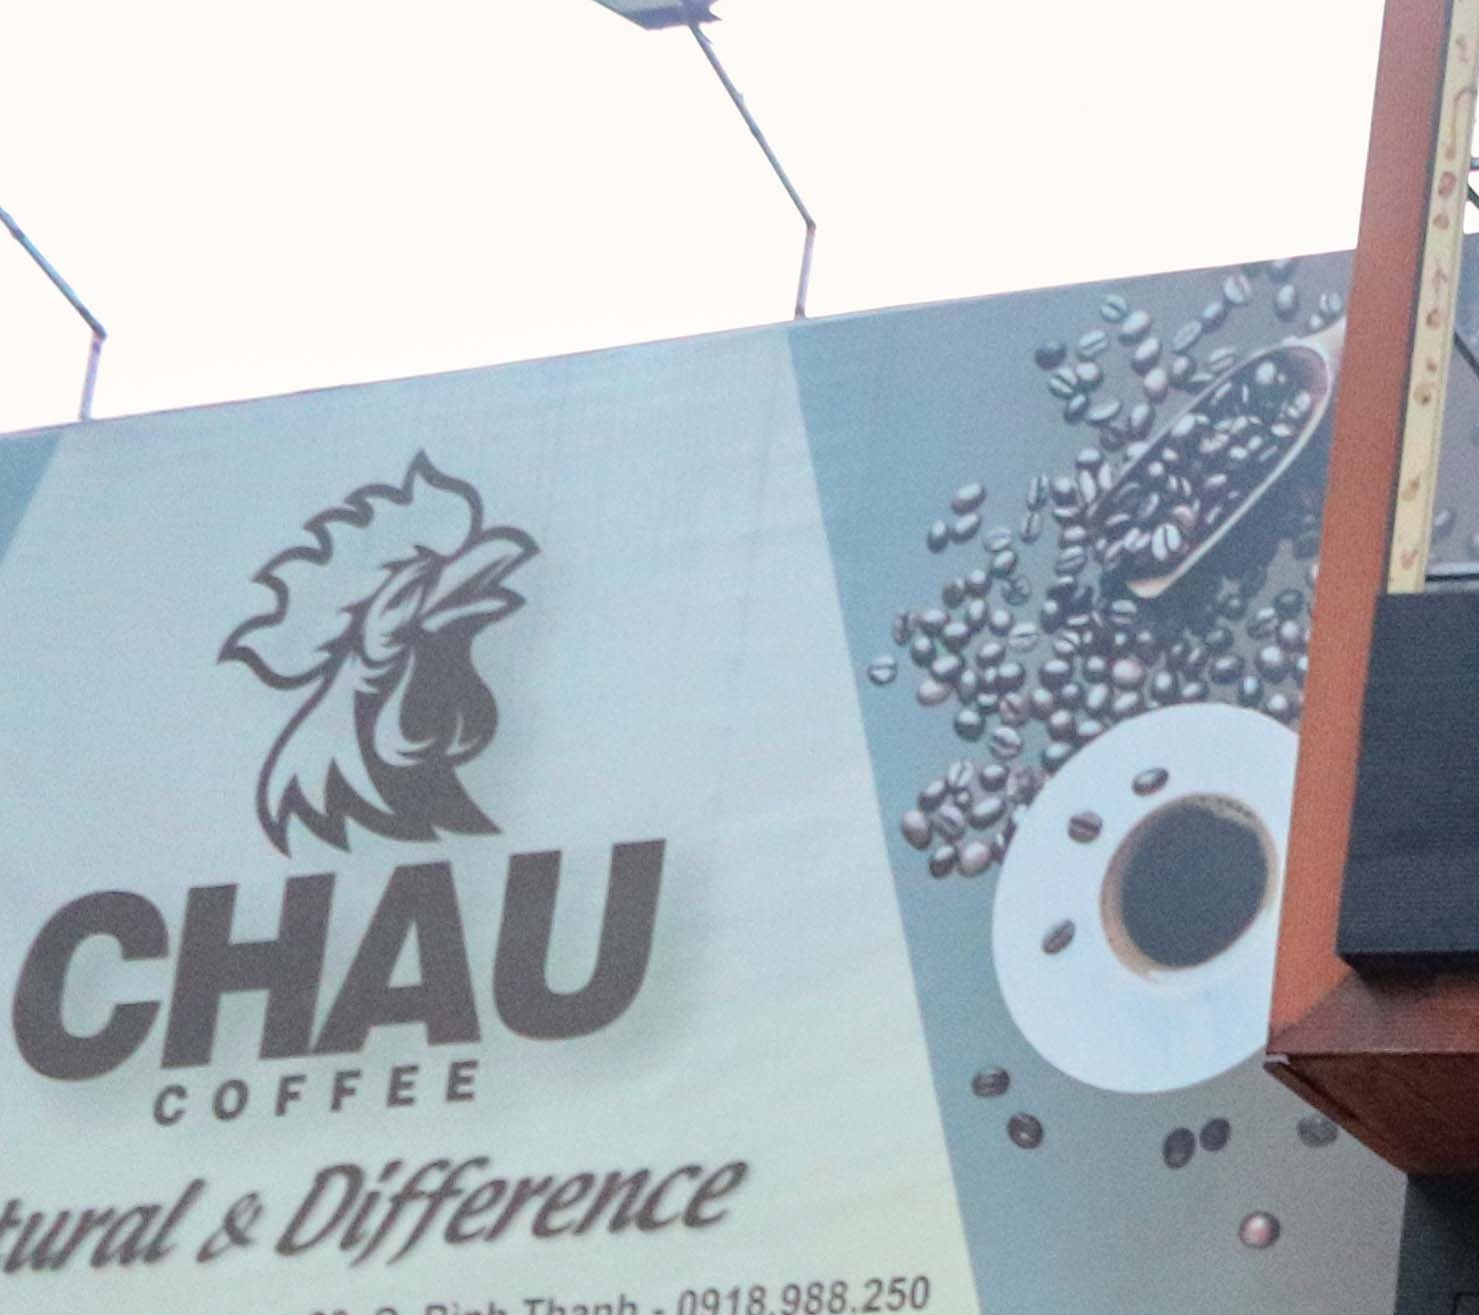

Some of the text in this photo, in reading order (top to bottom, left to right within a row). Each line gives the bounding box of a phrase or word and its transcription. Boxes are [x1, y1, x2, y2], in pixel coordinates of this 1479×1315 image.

[12, 838, 666, 1082] CHAU
[152, 1060, 479, 1126] COFFEE
[196, 1190, 263, 1263] &
[275, 1156, 749, 1264] Difference
